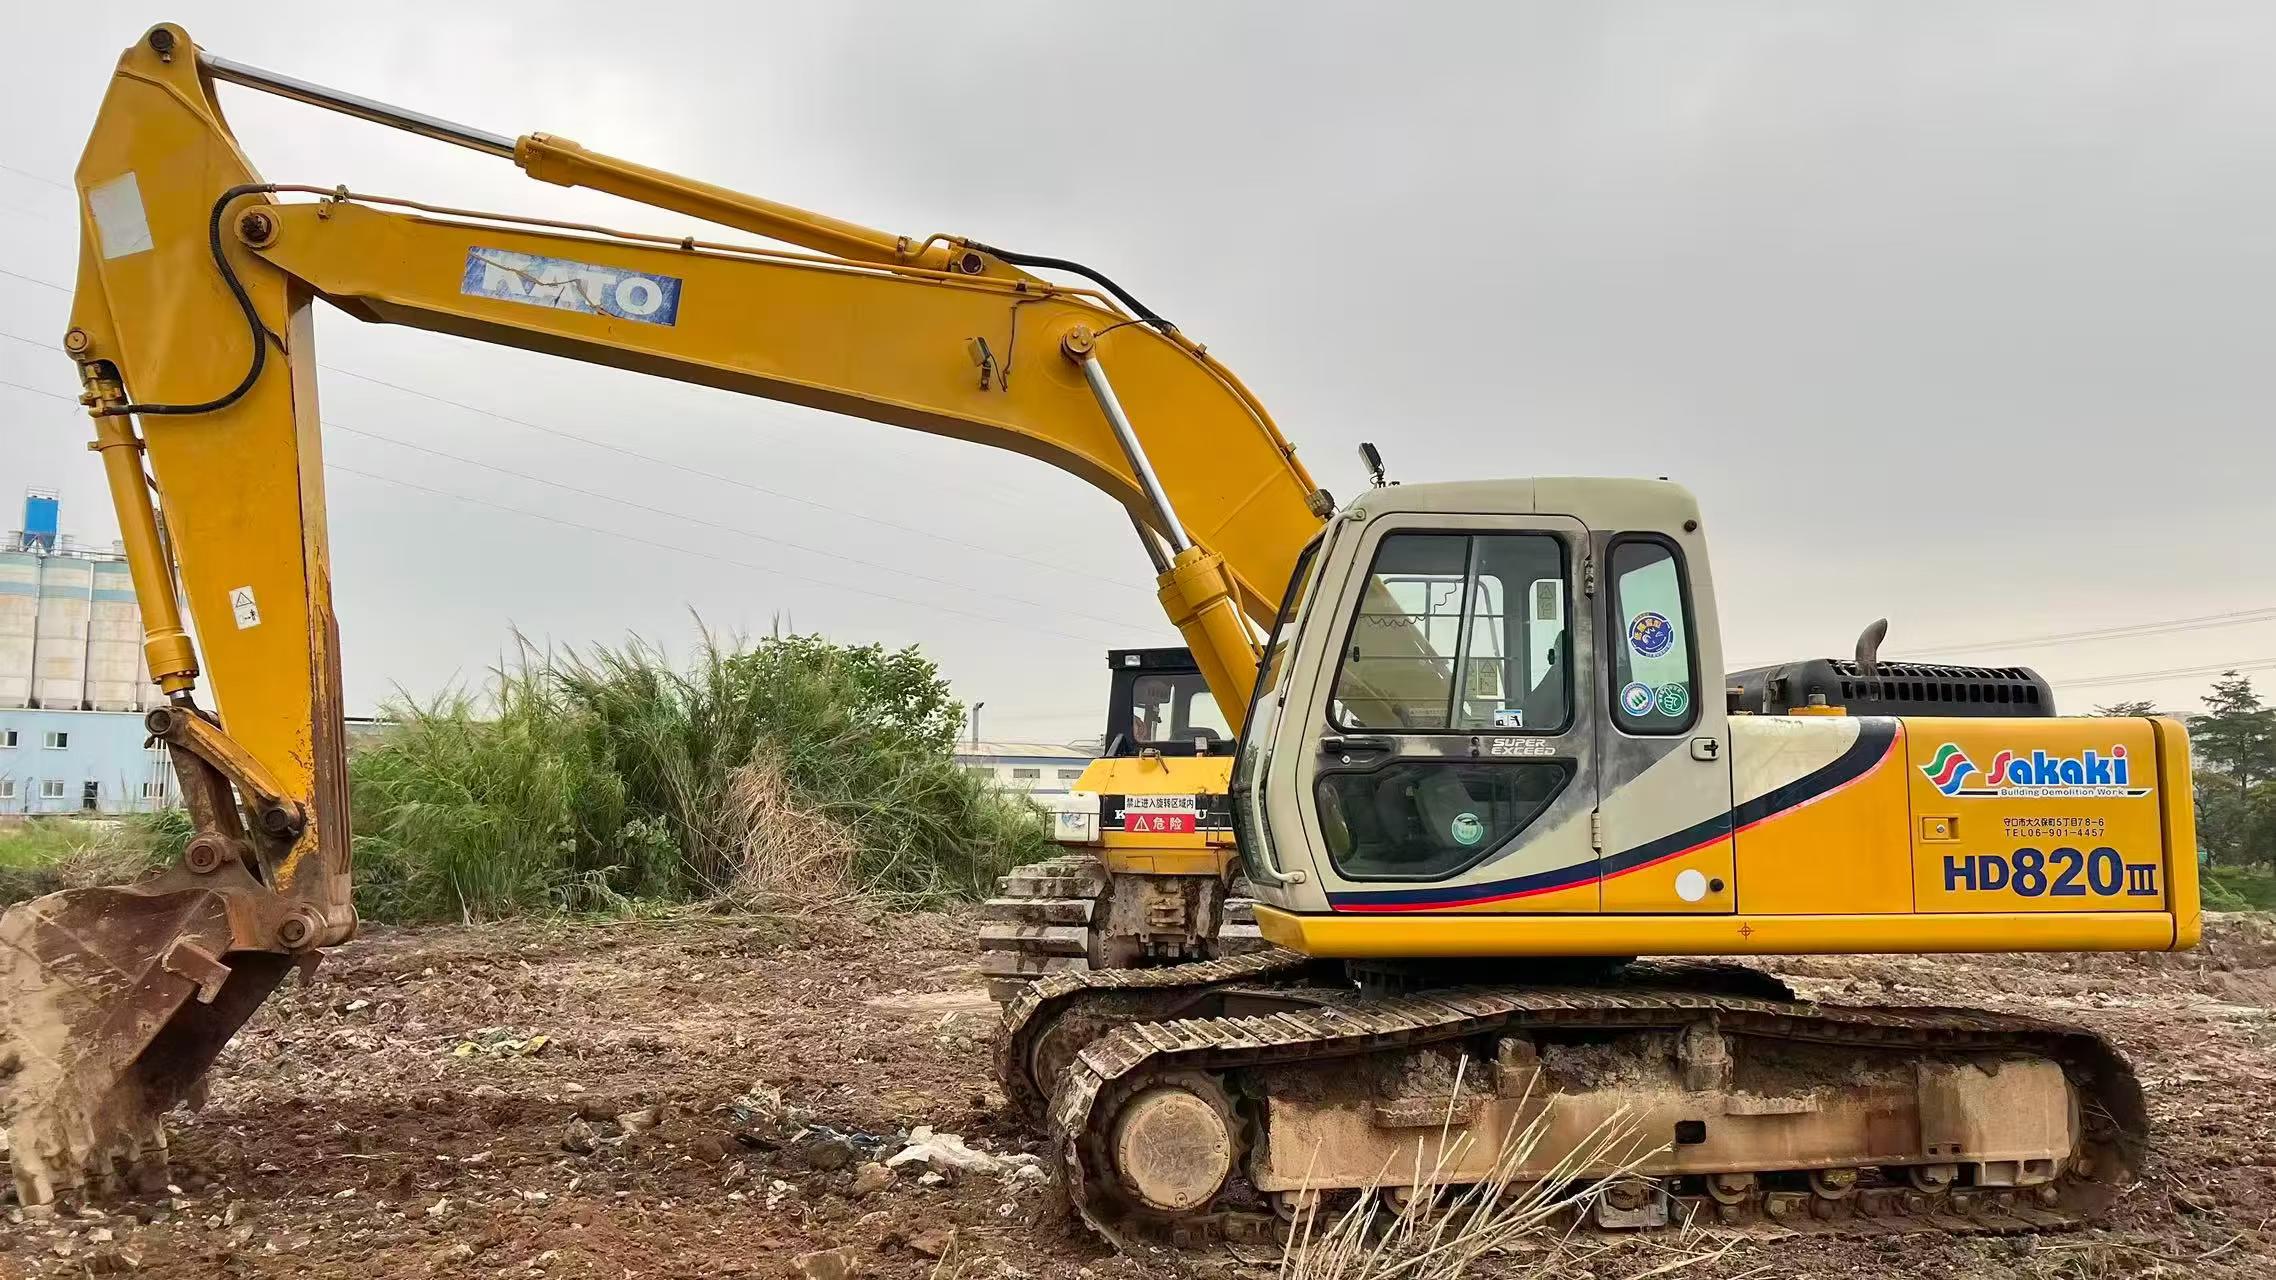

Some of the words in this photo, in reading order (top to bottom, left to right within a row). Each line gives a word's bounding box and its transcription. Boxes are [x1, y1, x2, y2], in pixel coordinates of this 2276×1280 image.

[1493, 738, 1546, 747] SUPER
[1491, 747, 1556, 755] EXCEED
[1986, 744, 2129, 786] Sakaki
[2001, 788, 2040, 797] Building
[2042, 788, 2094, 796] Demolition
[2097, 788, 2124, 796] Work
[1126, 797, 1194, 809] 禁止进入旋转区域内
[1152, 816, 1183, 831] 危险
